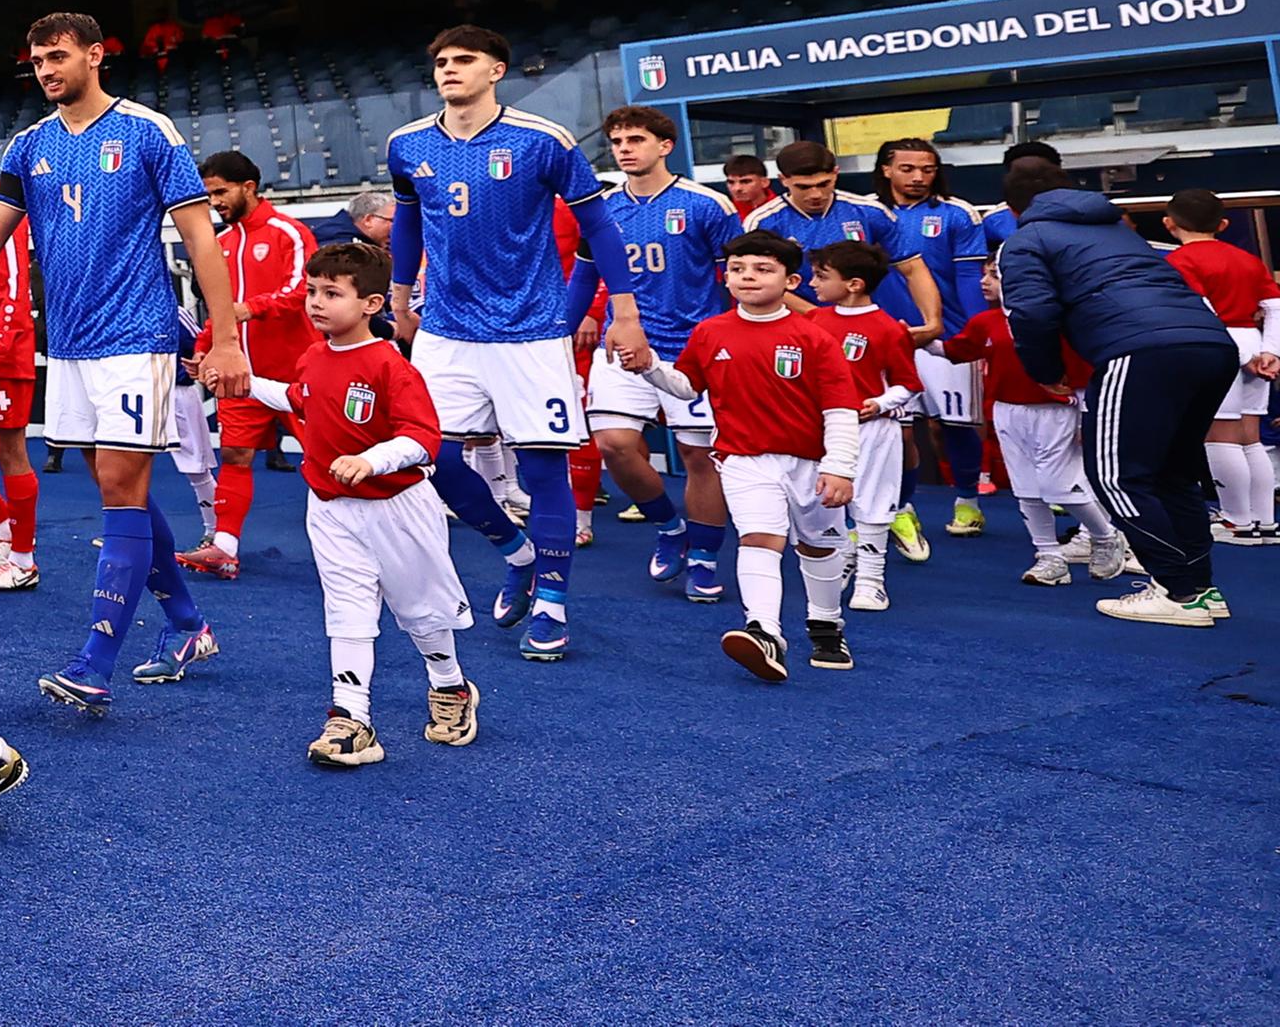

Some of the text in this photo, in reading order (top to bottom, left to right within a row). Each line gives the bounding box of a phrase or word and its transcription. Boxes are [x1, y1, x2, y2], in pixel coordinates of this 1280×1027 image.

[685, 46, 782, 77] ITALIA
[806, 17, 1028, 63] MACEDONIA
[1034, 7, 1111, 37] DEL
[62, 183, 82, 223] 4
[447, 181, 469, 217] 3
[624, 242, 665, 273] 20
[350, 389, 372, 399] ITALIA
[942, 390, 963, 416] 11
[121, 393, 143, 435] 4
[546, 397, 570, 434] 3
